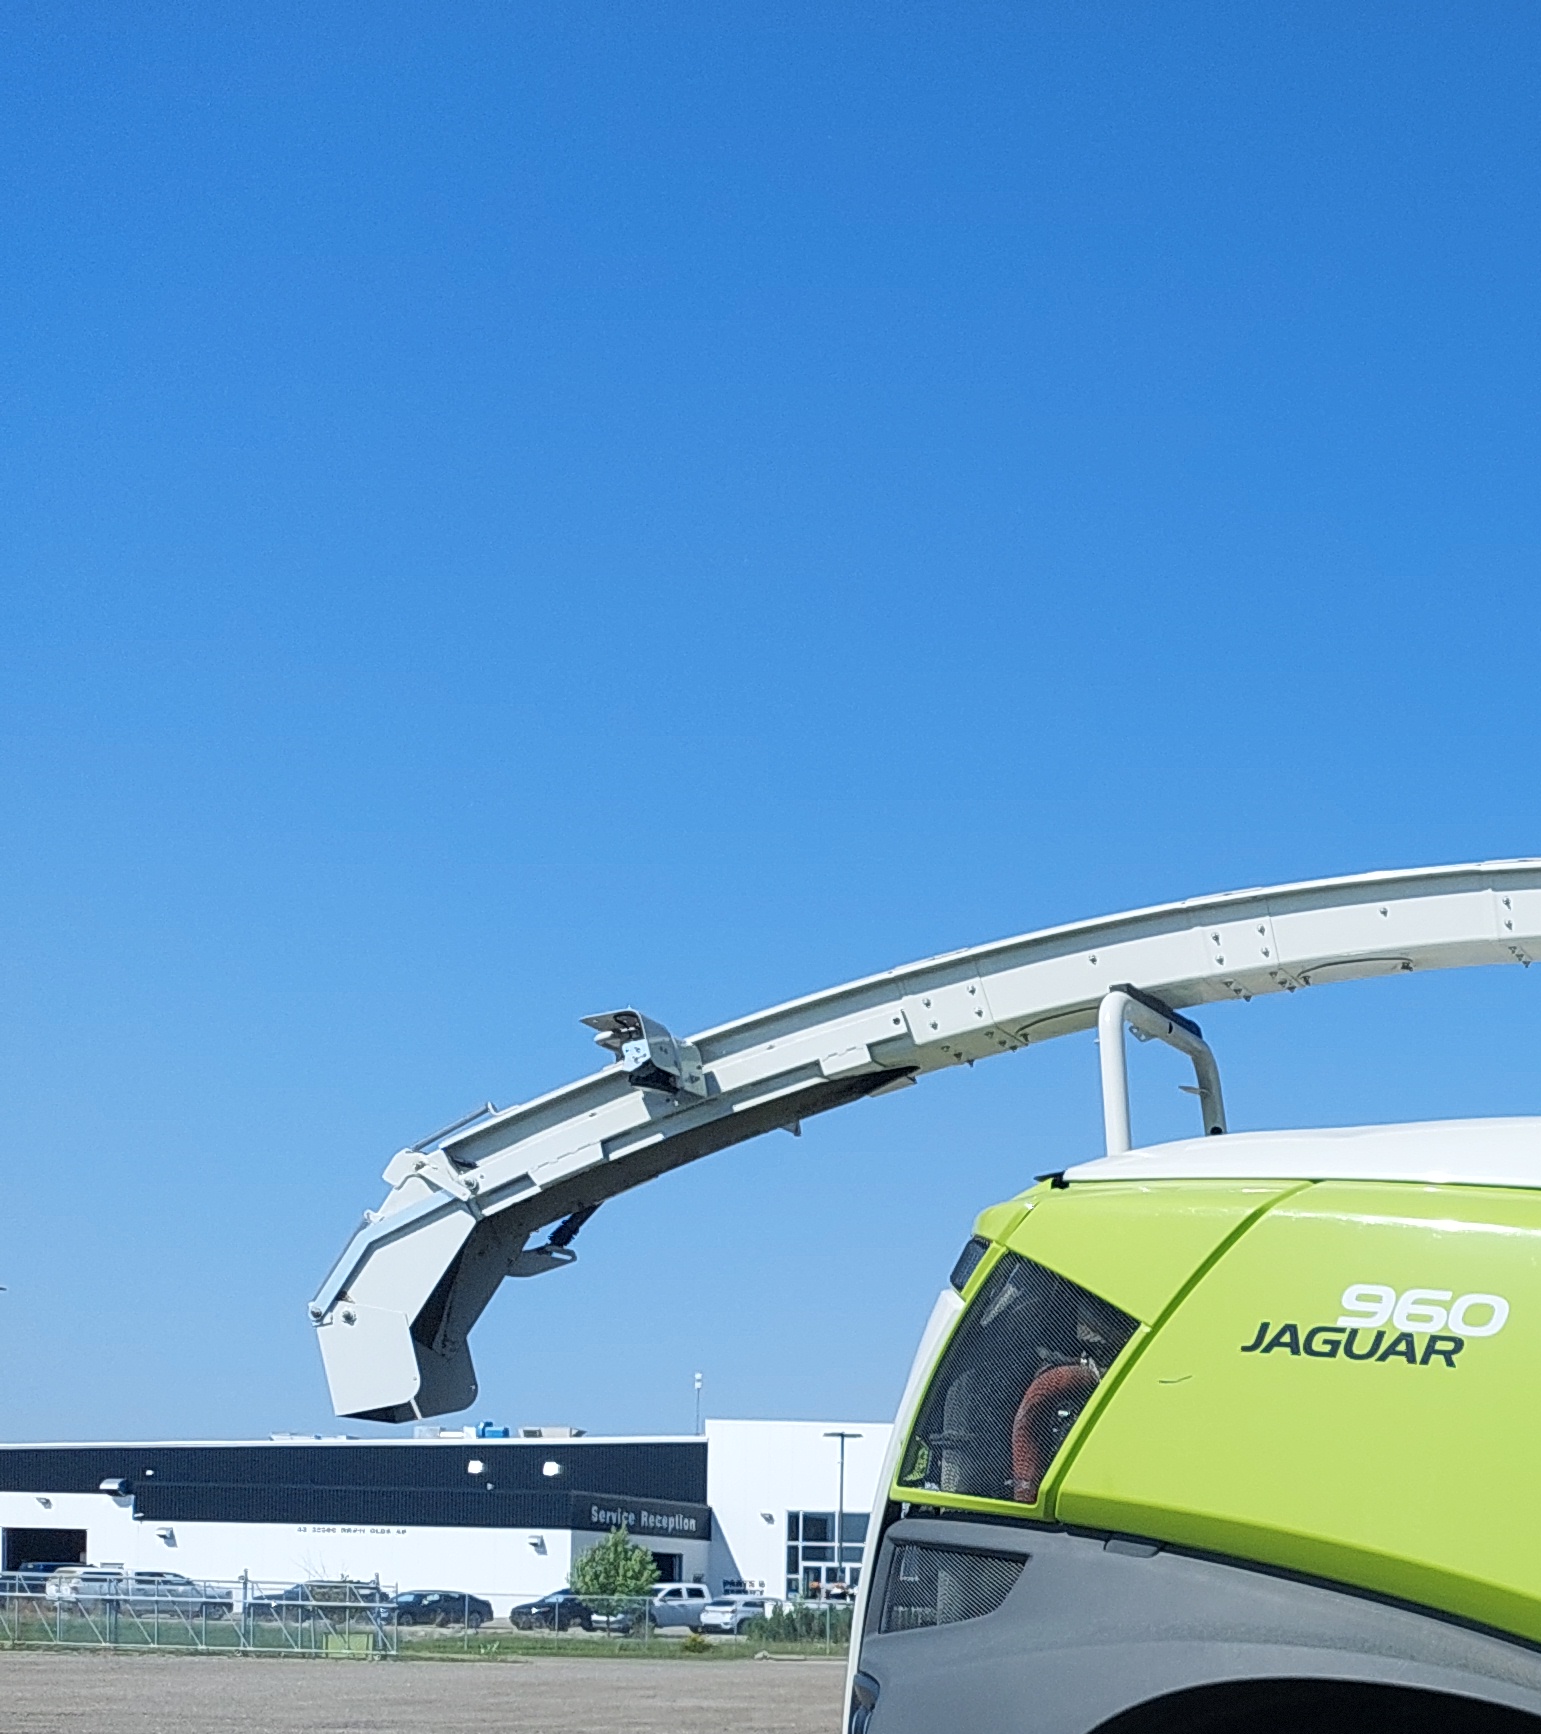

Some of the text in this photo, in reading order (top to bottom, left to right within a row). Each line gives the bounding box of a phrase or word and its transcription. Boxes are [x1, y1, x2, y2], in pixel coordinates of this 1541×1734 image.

[1336, 1284, 1510, 1337] 960
[1240, 1321, 1465, 1369] JAGUAR
[591, 1505, 697, 1533] Service Reception
